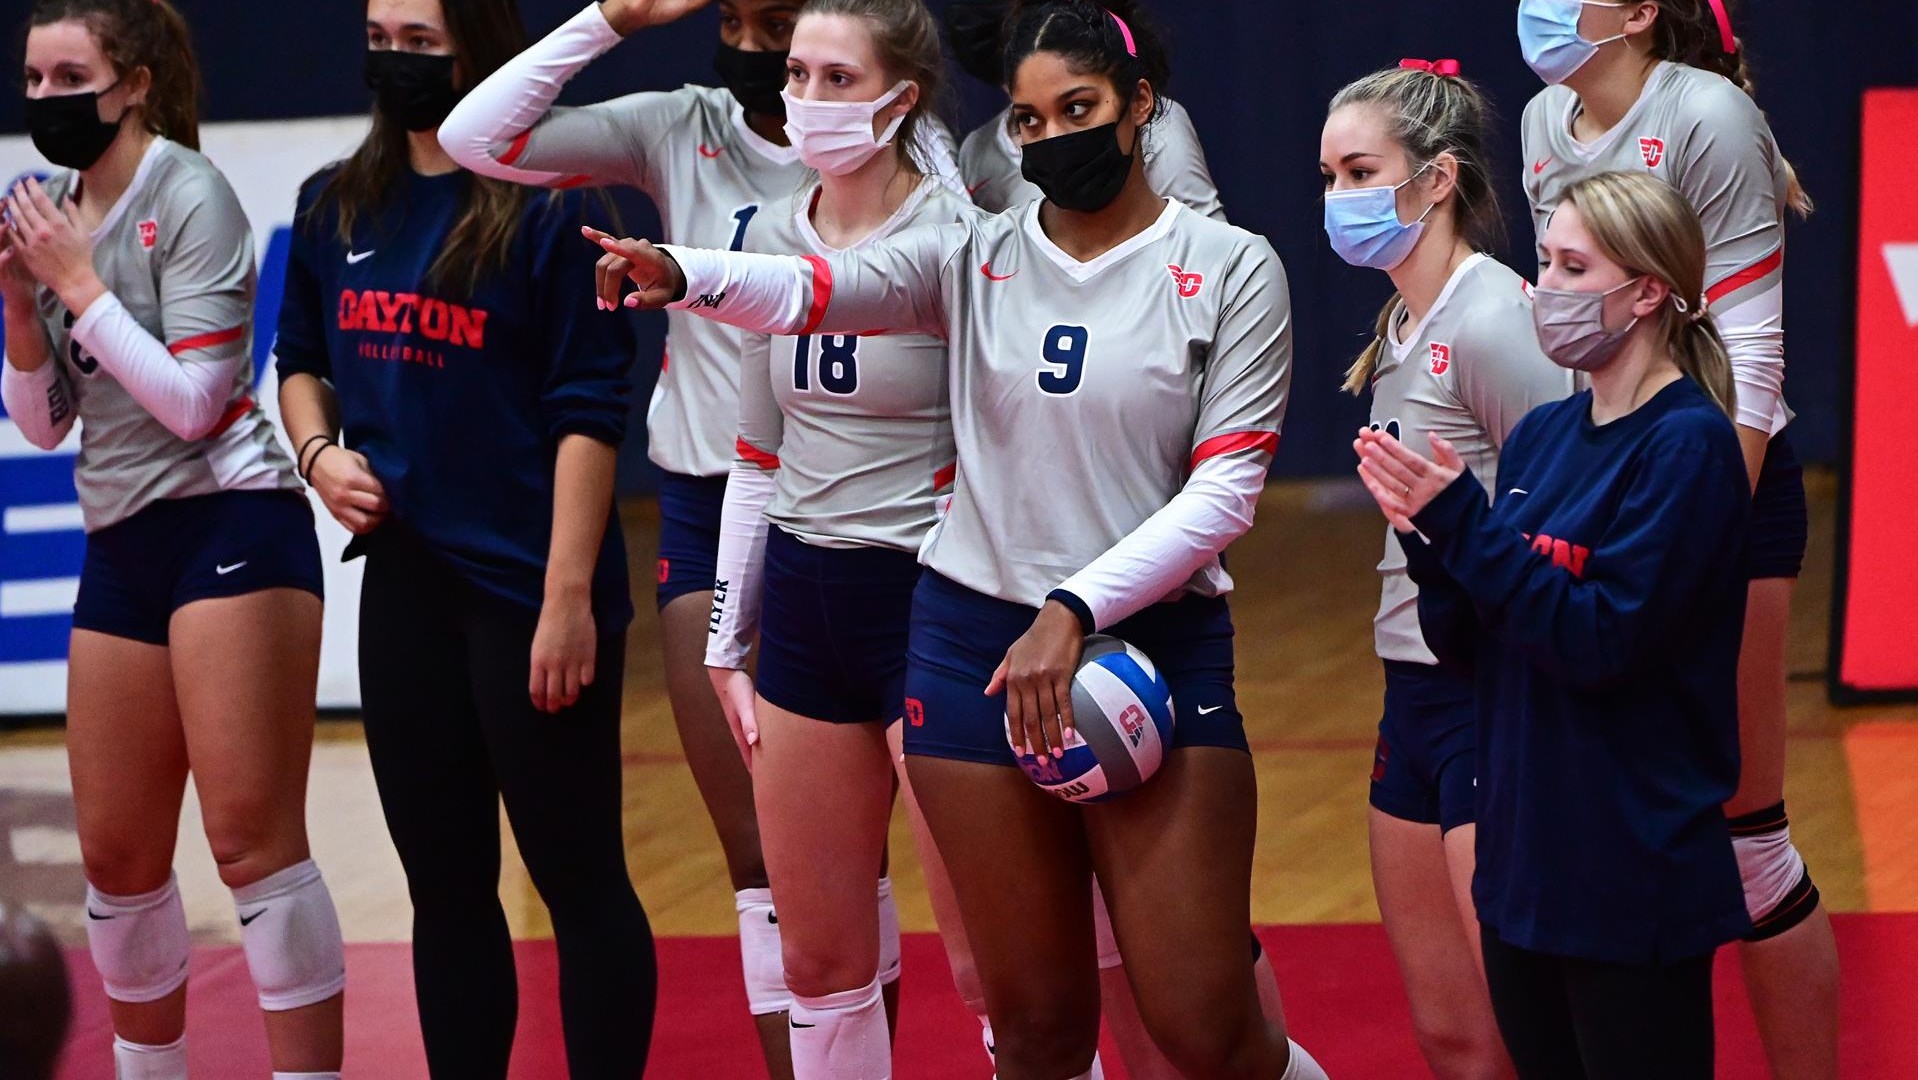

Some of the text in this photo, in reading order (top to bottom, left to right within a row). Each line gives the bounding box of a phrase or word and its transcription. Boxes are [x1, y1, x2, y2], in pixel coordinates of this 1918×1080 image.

[338, 288, 488, 348] DAYTON
[358, 342, 445, 368] OLLBALL
[793, 335, 858, 395] 18
[1037, 324, 1090, 395] 9
[709, 579, 729, 634] FLYER
